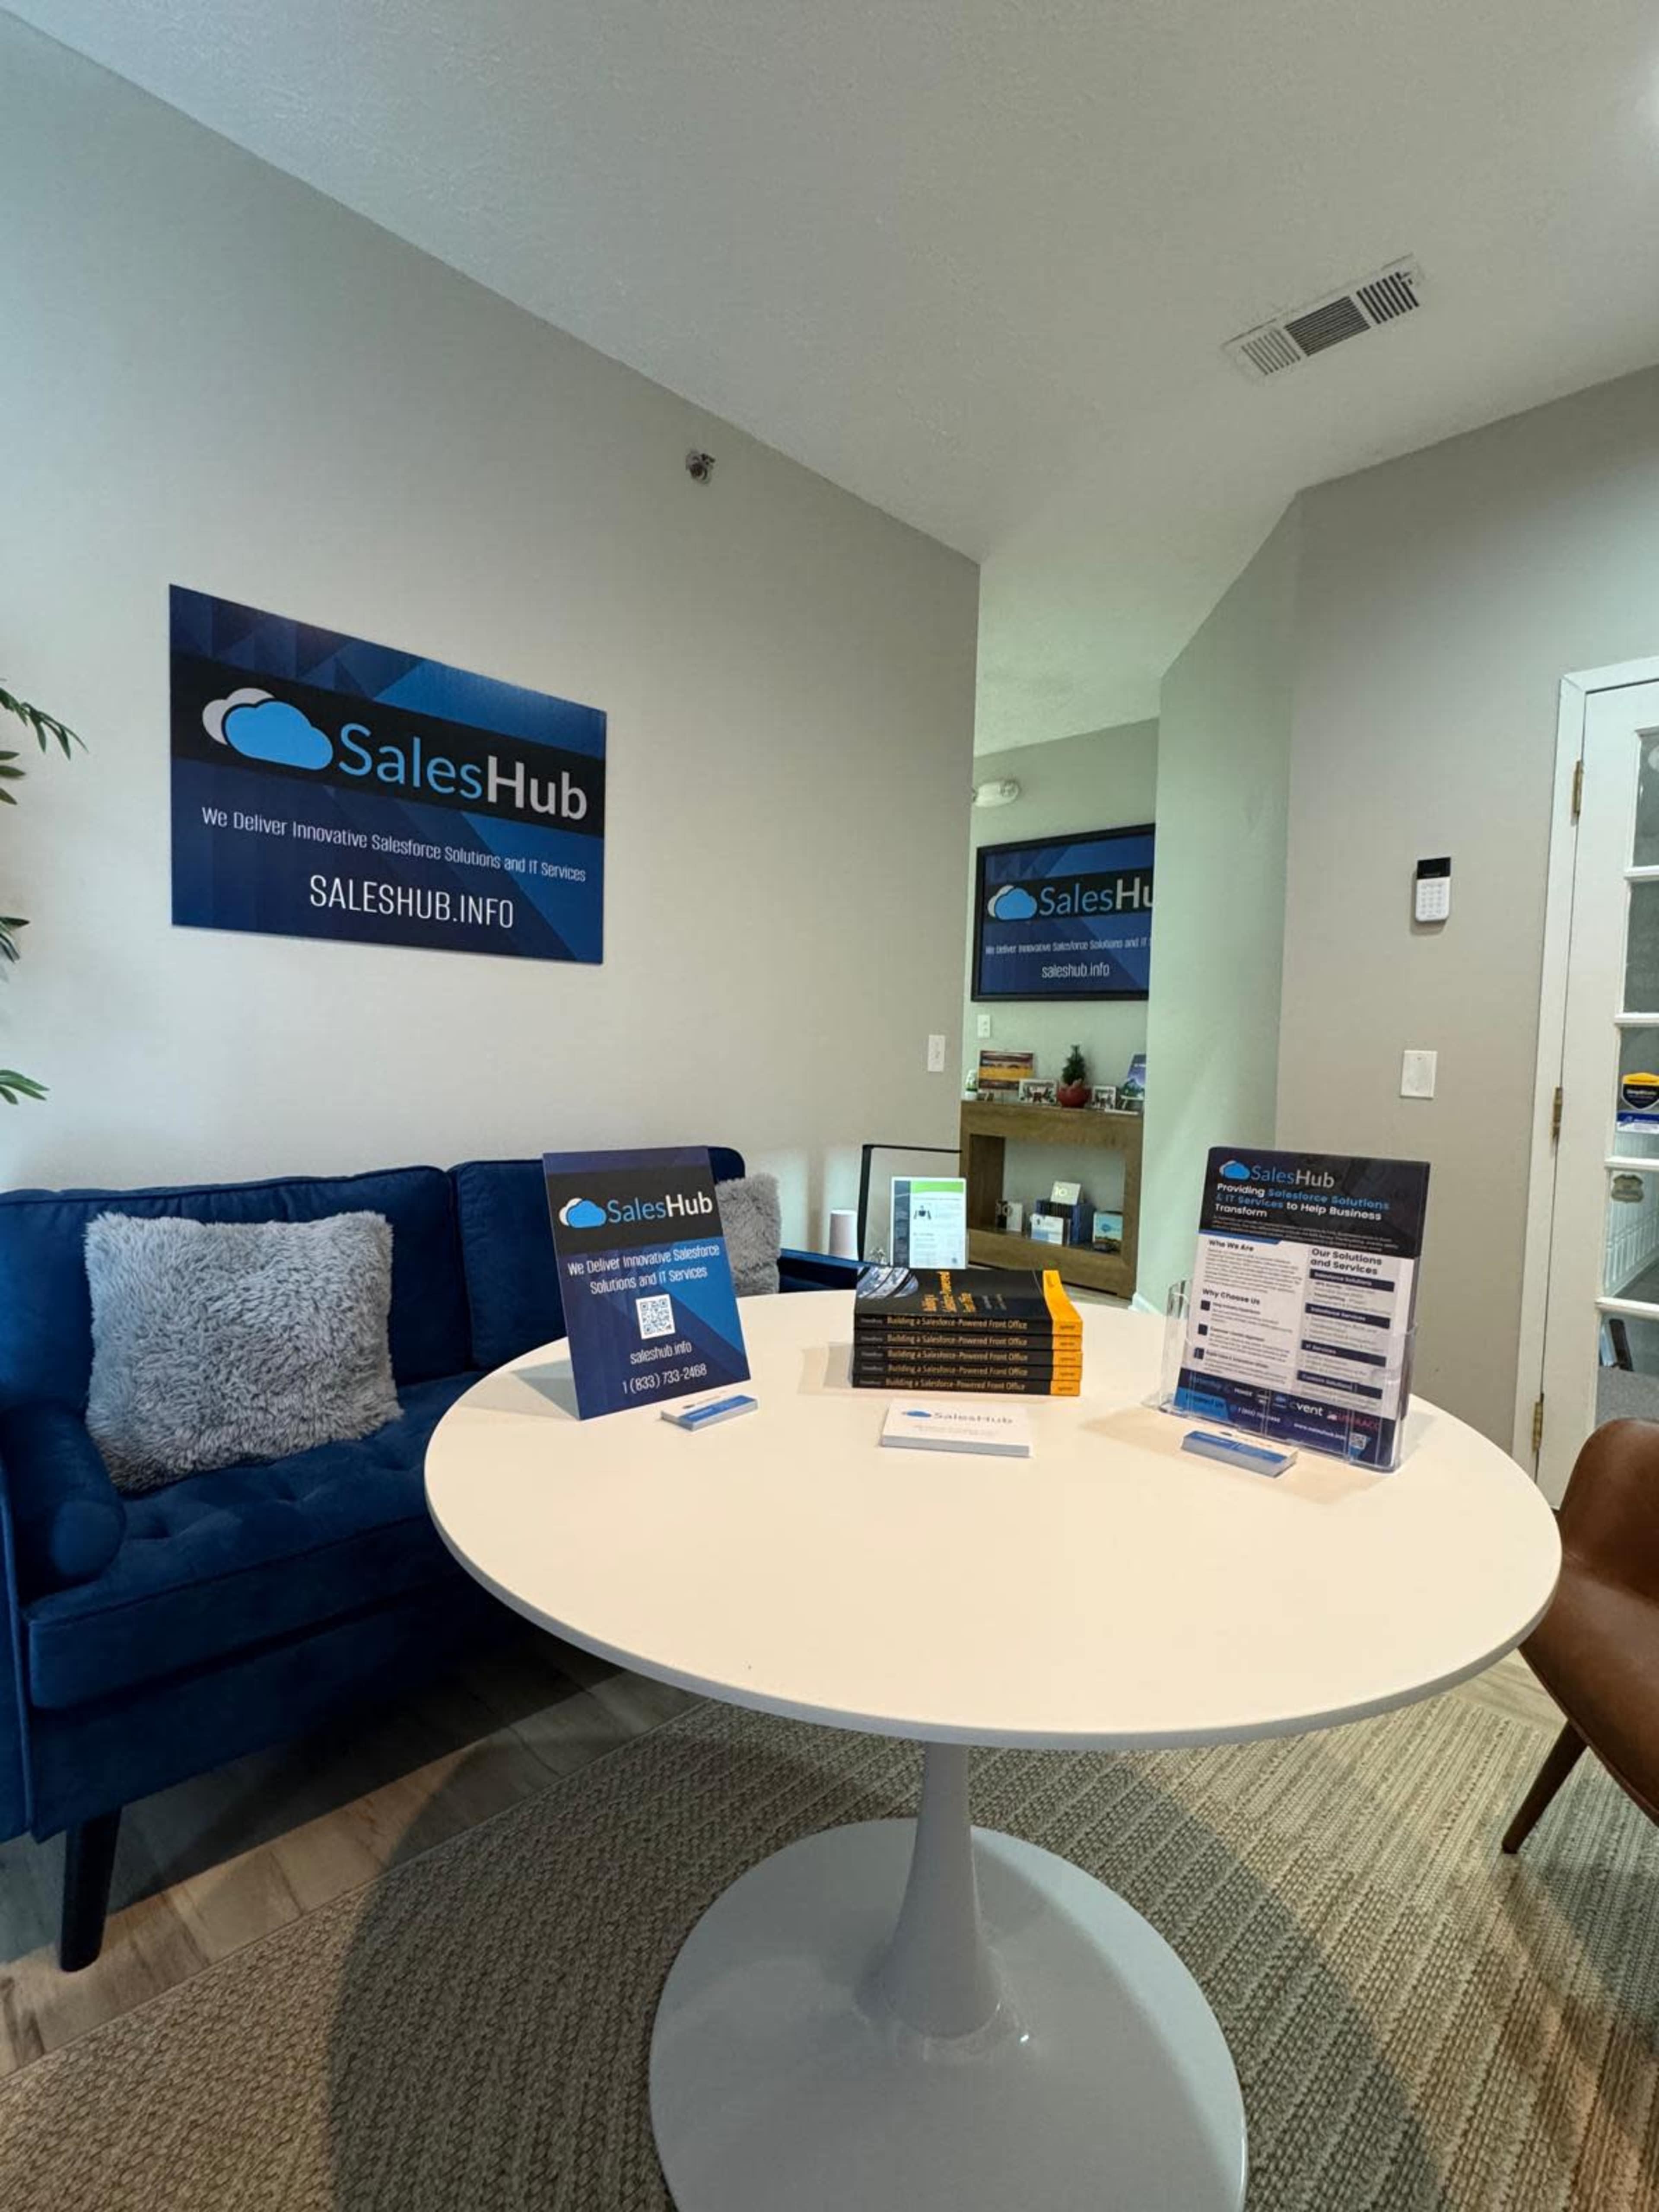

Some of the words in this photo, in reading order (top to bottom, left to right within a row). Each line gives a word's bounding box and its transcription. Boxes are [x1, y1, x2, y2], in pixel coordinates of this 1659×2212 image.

[339, 723, 587, 820] SalesHub
[202, 807, 227, 827] We
[233, 811, 287, 836] Deliver
[292, 821, 367, 848] Innovative
[372, 834, 441, 860] Salesforce
[445, 846, 501, 869] Solutions
[504, 857, 526, 873] and
[528, 861, 537, 874] IT
[541, 862, 586, 882] Services
[310, 874, 513, 928] SALESHUB.INFO
[1090, 939, 1122, 950] Solutions
[1125, 938, 1138, 948] and
[1042, 962, 1110, 979] saleshub.info
[1250, 1165, 1335, 1188] SalesHub
[607, 1191, 713, 1223] SalesHub
[1217, 1183, 1265, 1198] Providing
[1268, 1188, 1328, 1203] Salesforce
[1332, 1195, 1390, 1211] Solutions
[1214, 1204, 1268, 1217] Transform
[1225, 1194, 1235, 1203] IT
[1238, 1196, 1284, 1209] Services
[1287, 1201, 1297, 1211] to
[1300, 1204, 1326, 1214] Help
[1329, 1206, 1382, 1221] Business
[568, 1262, 584, 1276] We
[586, 1258, 620, 1274] Deliver
[623, 1251, 671, 1268] Innovative
[673, 1245, 719, 1262] Salesforce
[1312, 1248, 1330, 1257] Our
[1332, 1251, 1382, 1265] Solutions
[1310, 1259, 1331, 1267] and
[1333, 1262, 1377, 1275] Services
[590, 1276, 636, 1295] Solutions
[639, 1273, 657, 1287] and
[659, 1271, 666, 1283] IT
[669, 1266, 708, 1282] Services
[1202, 1289, 1218, 1298] Why
[1220, 1292, 1249, 1303] Choose
[887, 1316, 914, 1326] Building
[1007, 1320, 1027, 1329] Office
[887, 1334, 915, 1344] Building
[630, 1341, 692, 1365] saleshub.info
[887, 1349, 915, 1360] Building
[623, 1381, 627, 1394] 1
[630, 1372, 660, 1394] (833)
[663, 1363, 707, 1385] 733-2468
[888, 1364, 916, 1374] Building
[989, 1367, 1007, 1375] Front
[1008, 1367, 1028, 1376] Office
[886, 1378, 912, 1389] Building
[987, 1381, 1004, 1389] Front
[1006, 1382, 1025, 1390] Office
